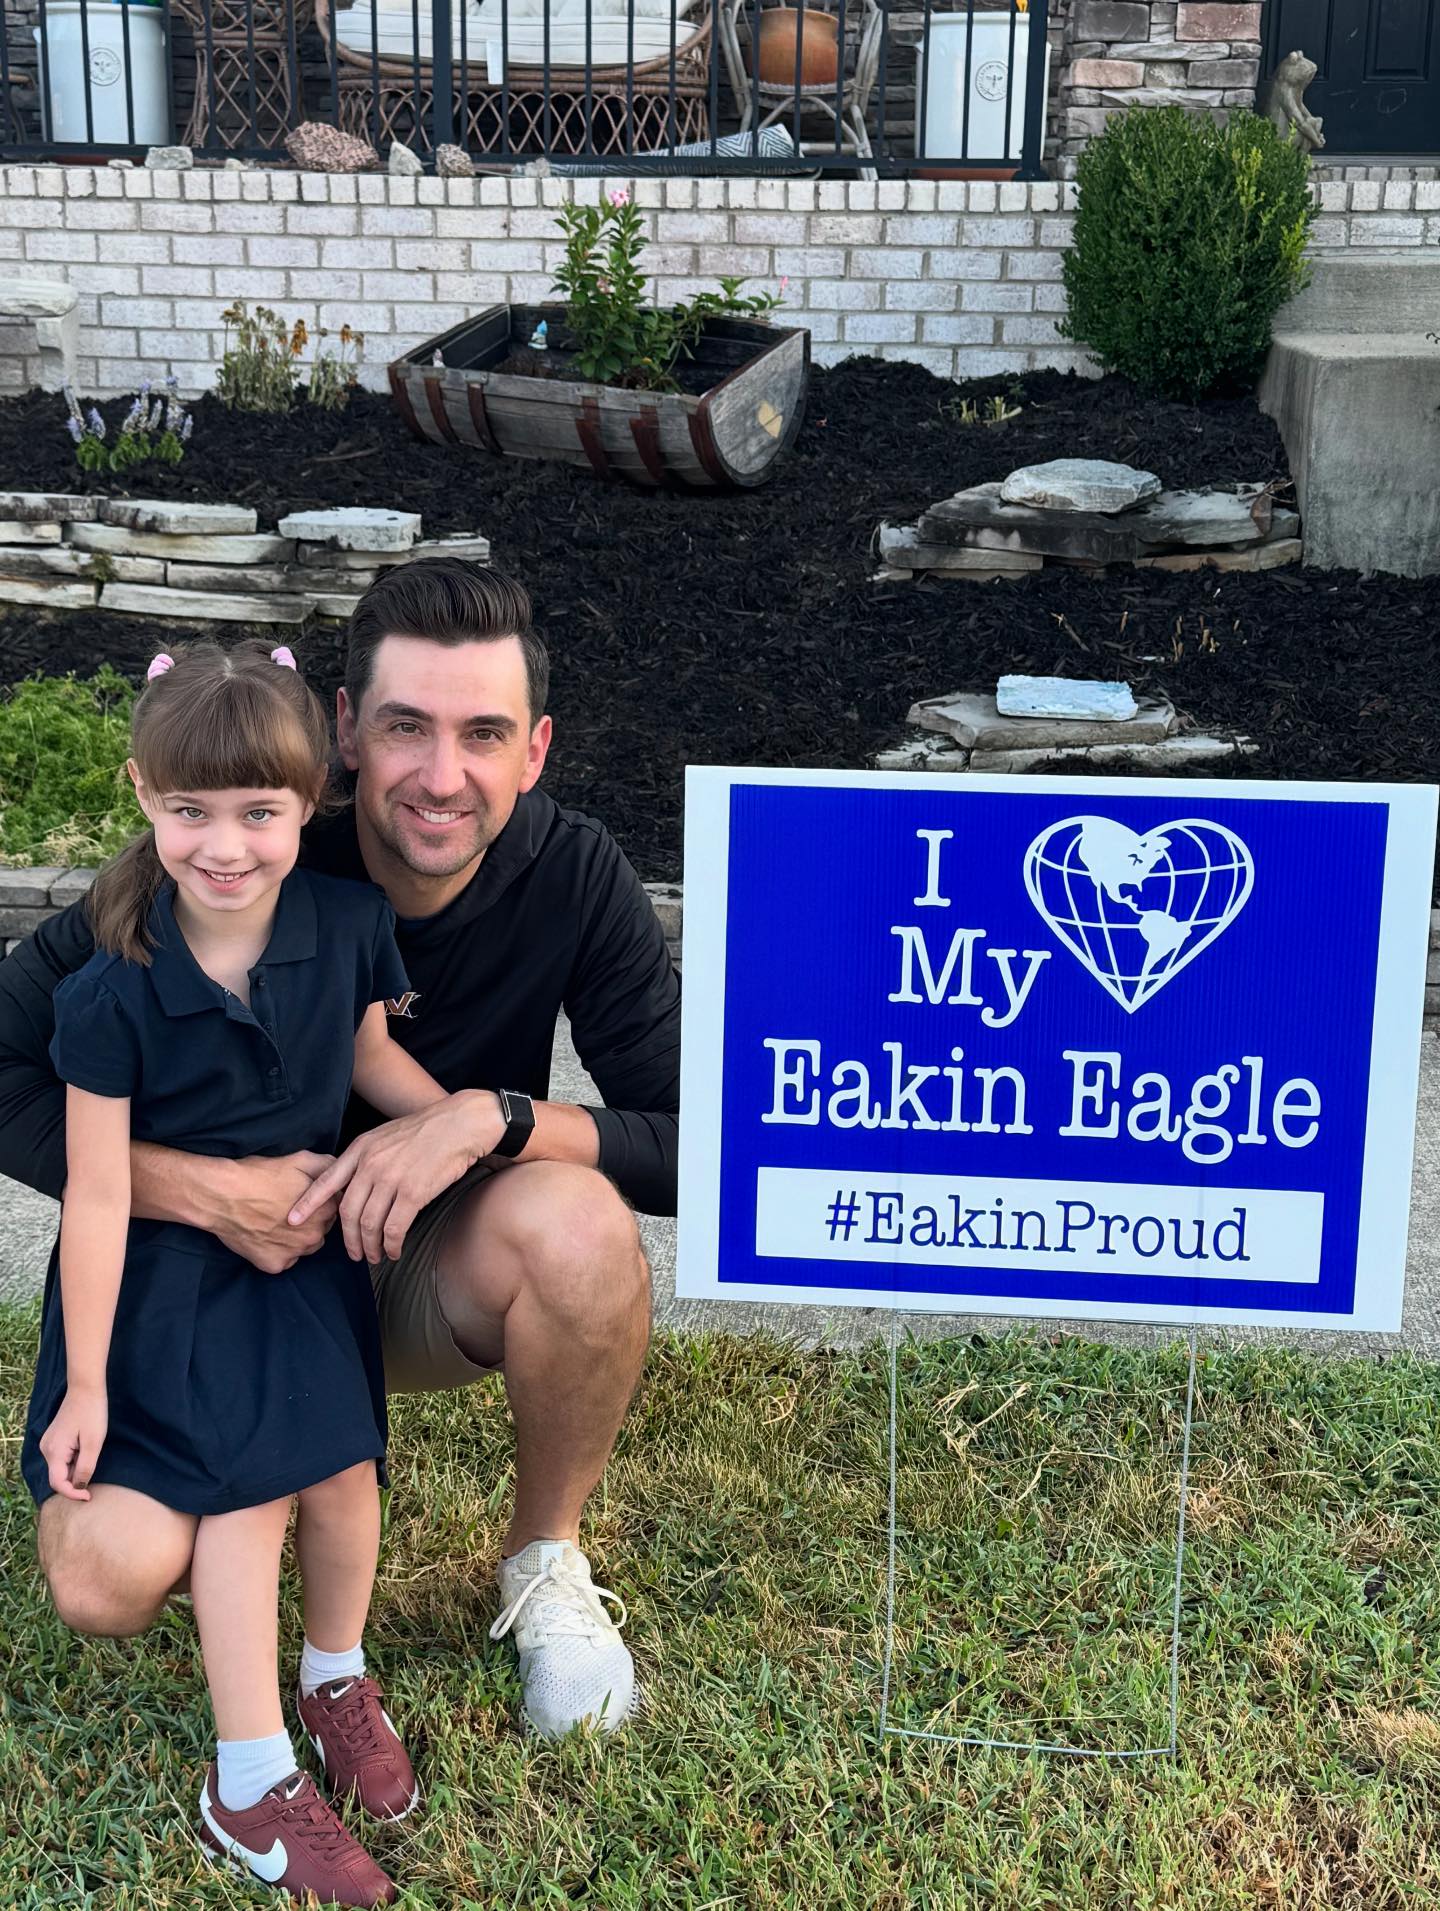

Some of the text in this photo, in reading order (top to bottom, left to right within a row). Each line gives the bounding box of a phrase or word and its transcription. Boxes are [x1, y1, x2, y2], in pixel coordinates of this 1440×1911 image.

[914, 829, 953, 906] I
[888, 926, 1051, 1028] My
[762, 1038, 1320, 1164] Eakin Eagle
[825, 1191, 1250, 1261] #EakinProud
